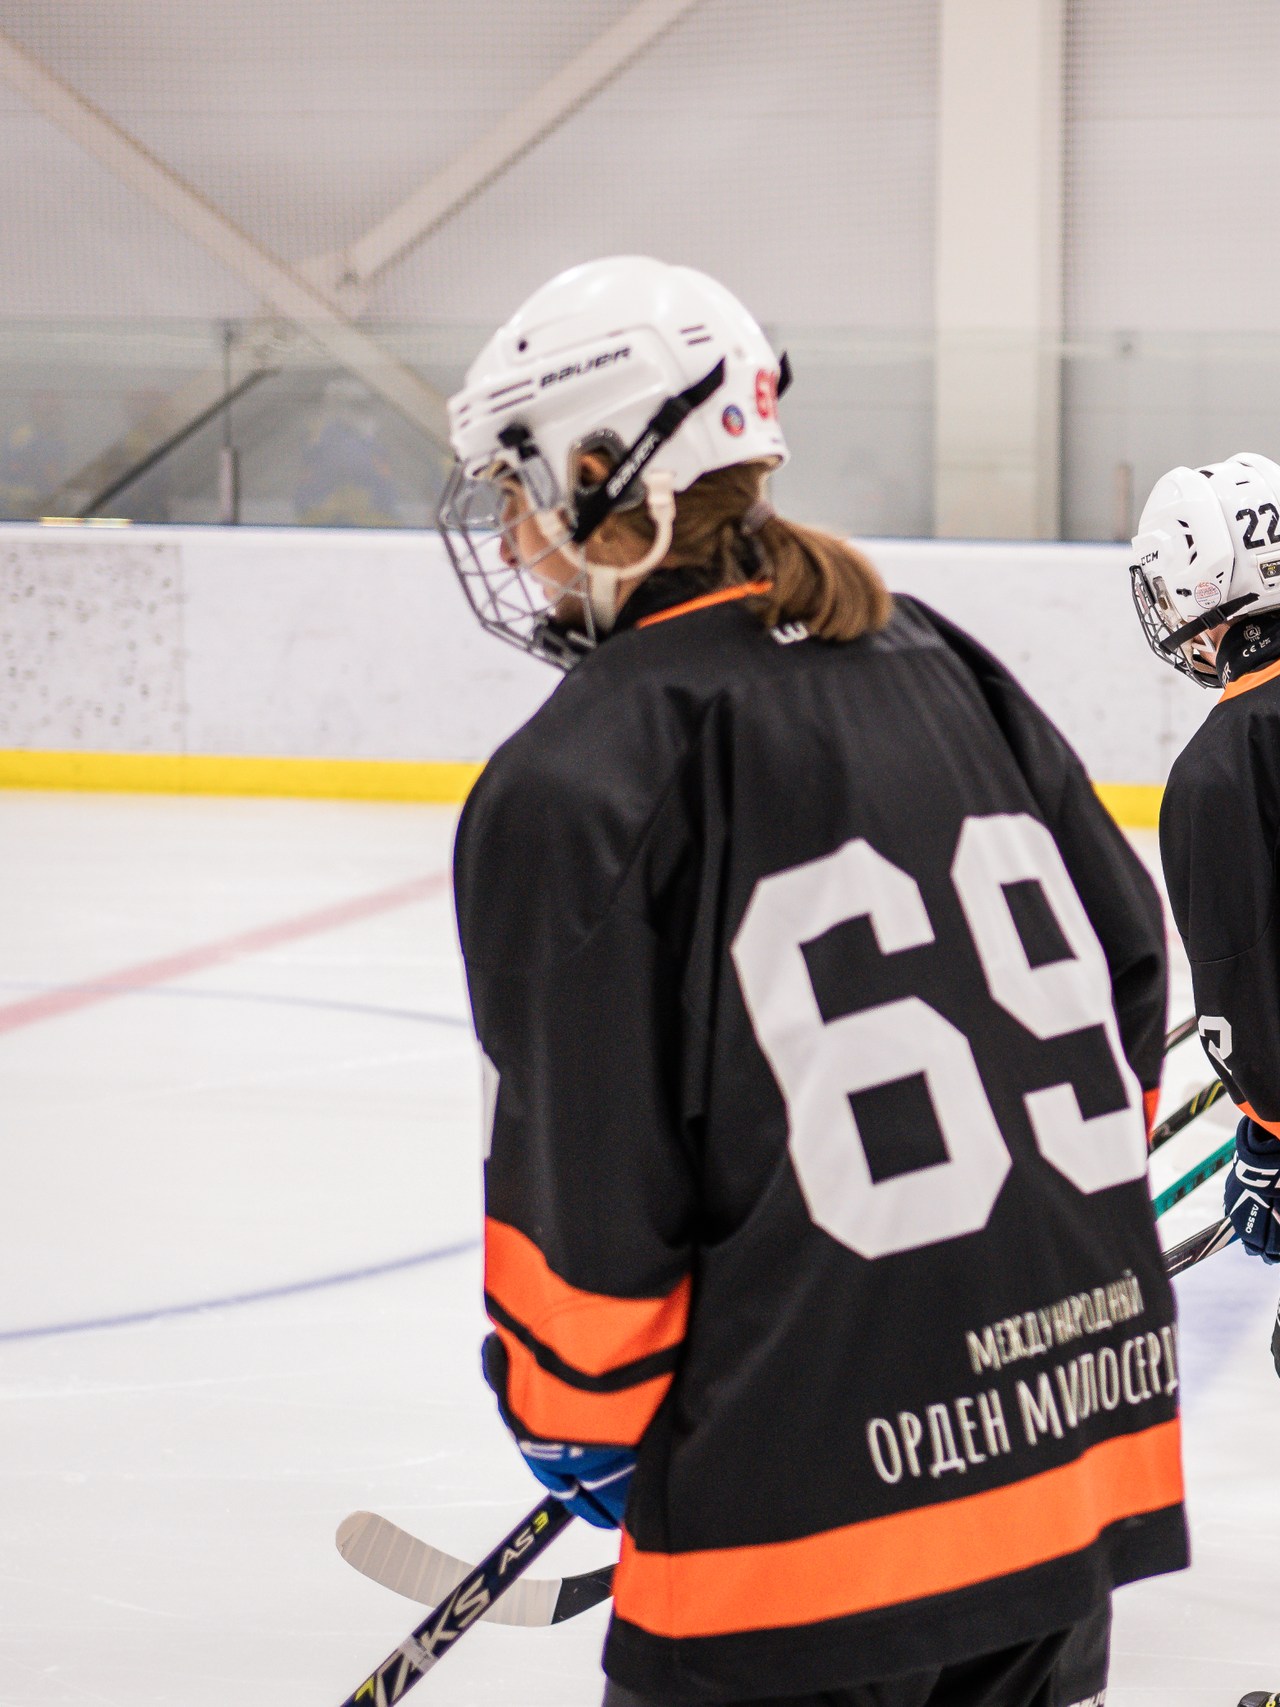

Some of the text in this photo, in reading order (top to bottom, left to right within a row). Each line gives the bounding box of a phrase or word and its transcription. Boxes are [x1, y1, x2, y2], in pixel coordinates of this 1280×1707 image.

[540, 347, 631, 388] BAUER
[1140, 550, 1159, 567] CCM
[730, 812, 1149, 1260] 69
[965, 1268, 1146, 1376] МЕЖДУНАРОДНЫЙ
[865, 1322, 1179, 1485] ОРДЕН МИЛОСЕРД
